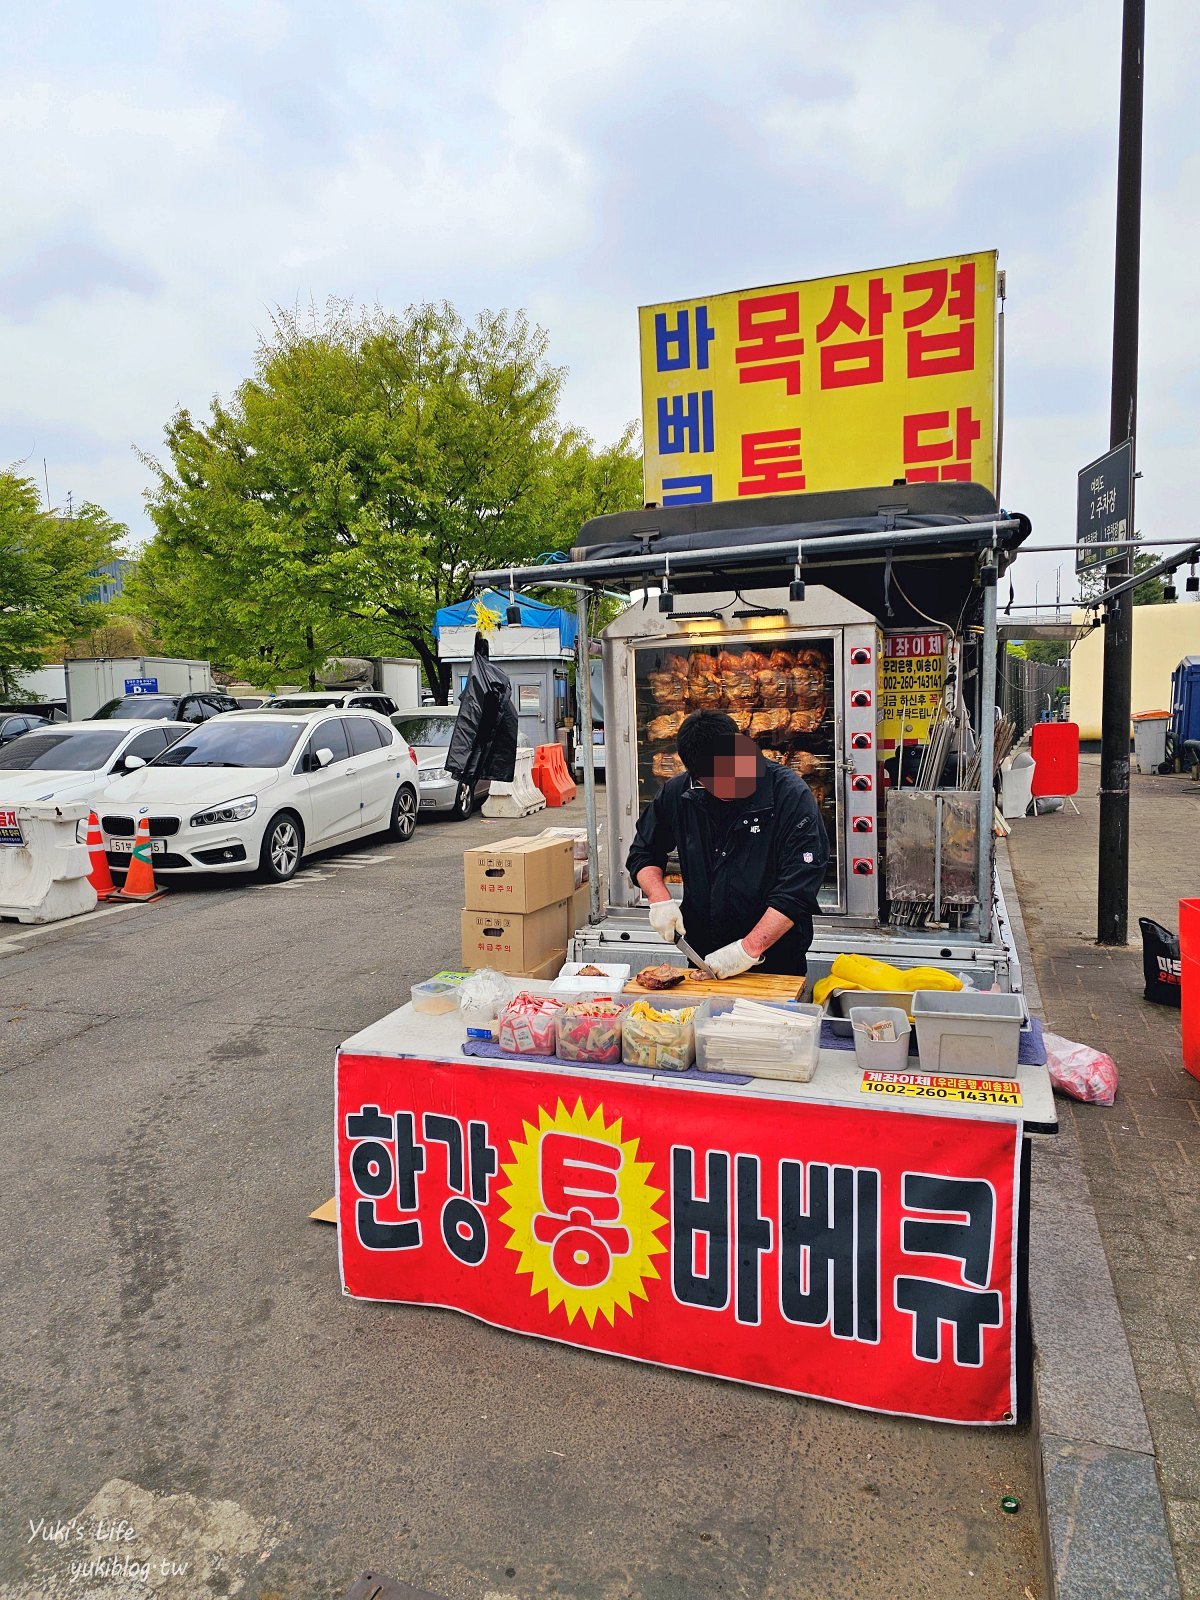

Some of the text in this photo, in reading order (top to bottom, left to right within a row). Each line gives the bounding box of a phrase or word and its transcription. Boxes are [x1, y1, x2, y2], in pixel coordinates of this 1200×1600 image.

[735, 262, 976, 396] 목삼겹
[1091, 475, 1105, 495] 여의도
[480, 884, 513, 893] 취급주의
[477, 943, 511, 953] 취급주의
[868, 1071, 1018, 1093] 계좌이체 (우리은행,이송희)
[866, 1083, 1018, 1104] 1002-260-143141
